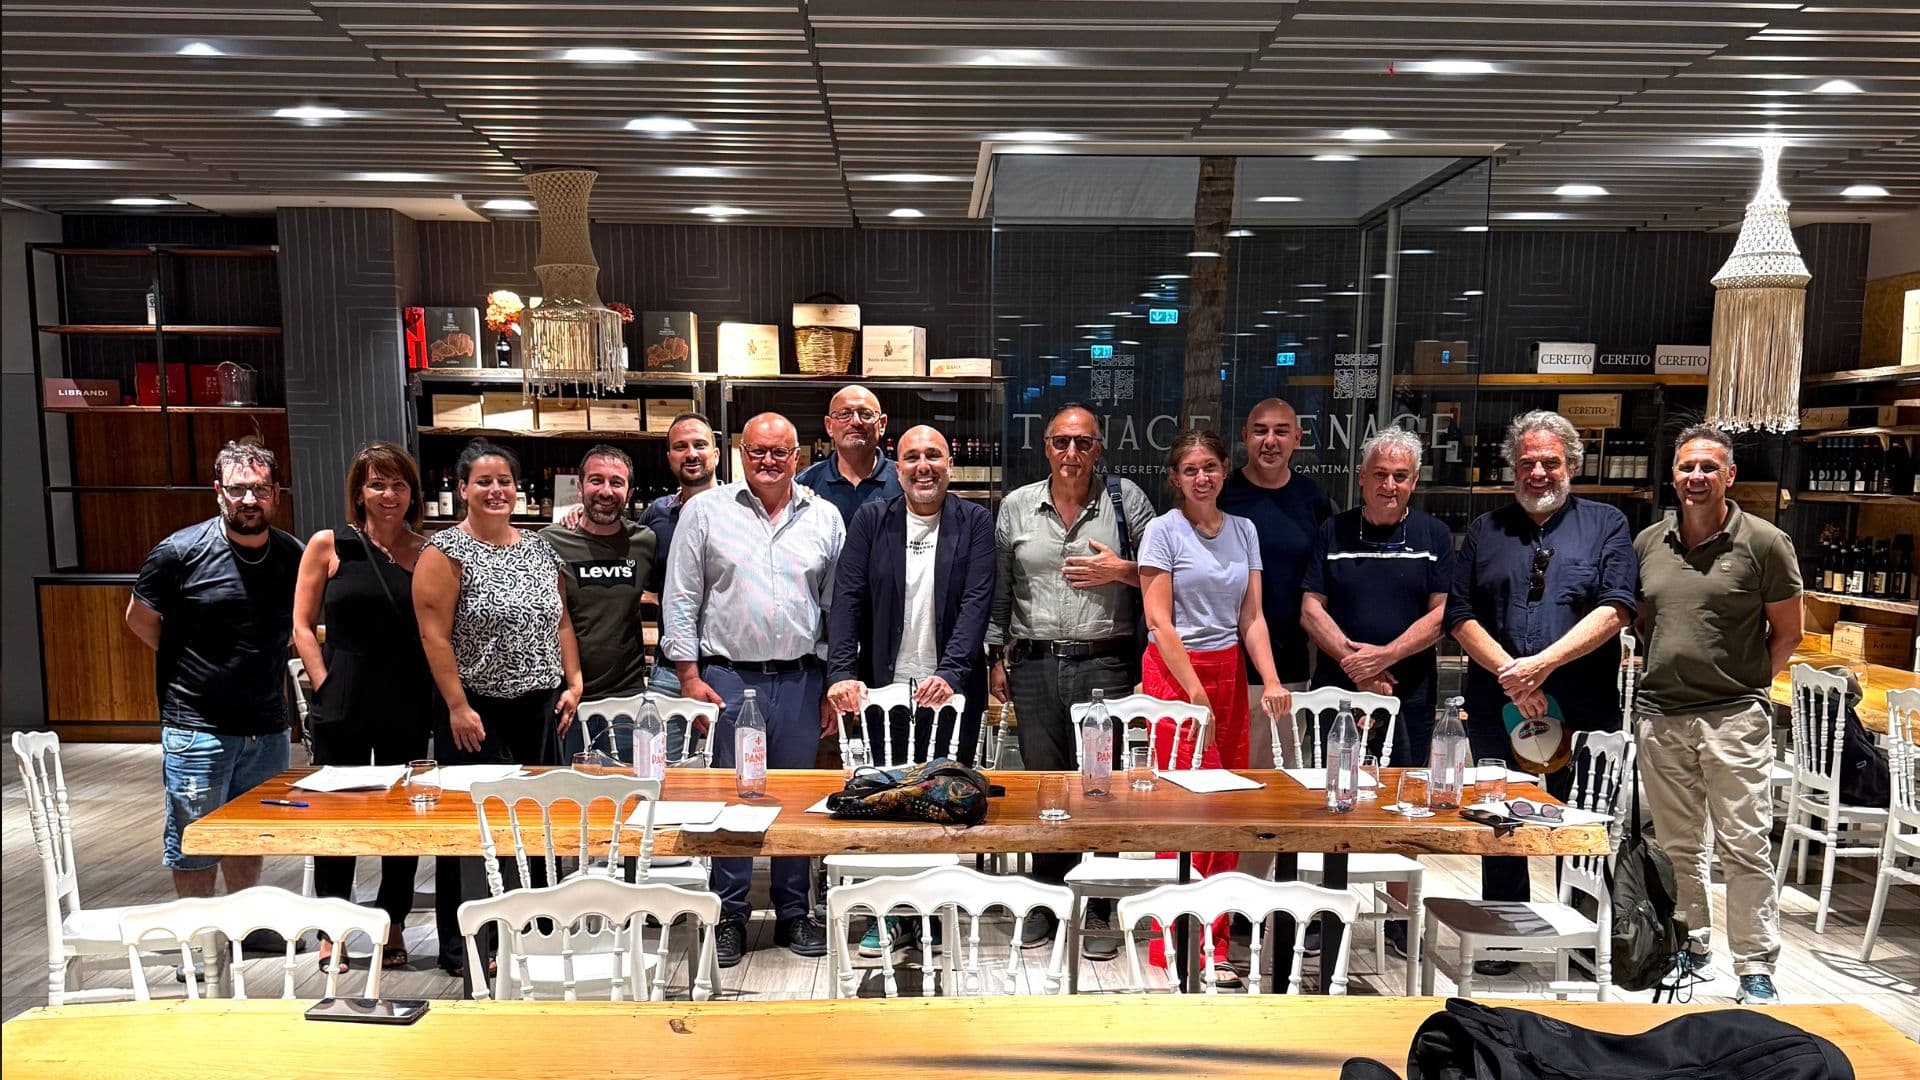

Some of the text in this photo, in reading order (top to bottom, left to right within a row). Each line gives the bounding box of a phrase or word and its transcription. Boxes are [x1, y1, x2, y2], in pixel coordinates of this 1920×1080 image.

[1541, 353, 1592, 365] CERETTO
[1600, 354, 1650, 366] CERETTO
[1658, 355, 1707, 367] CERETTO
[58, 389, 109, 397] LIBRANDI
[1568, 406, 1607, 415] CERETTO
[1294, 464, 1350, 475] CANTINA
